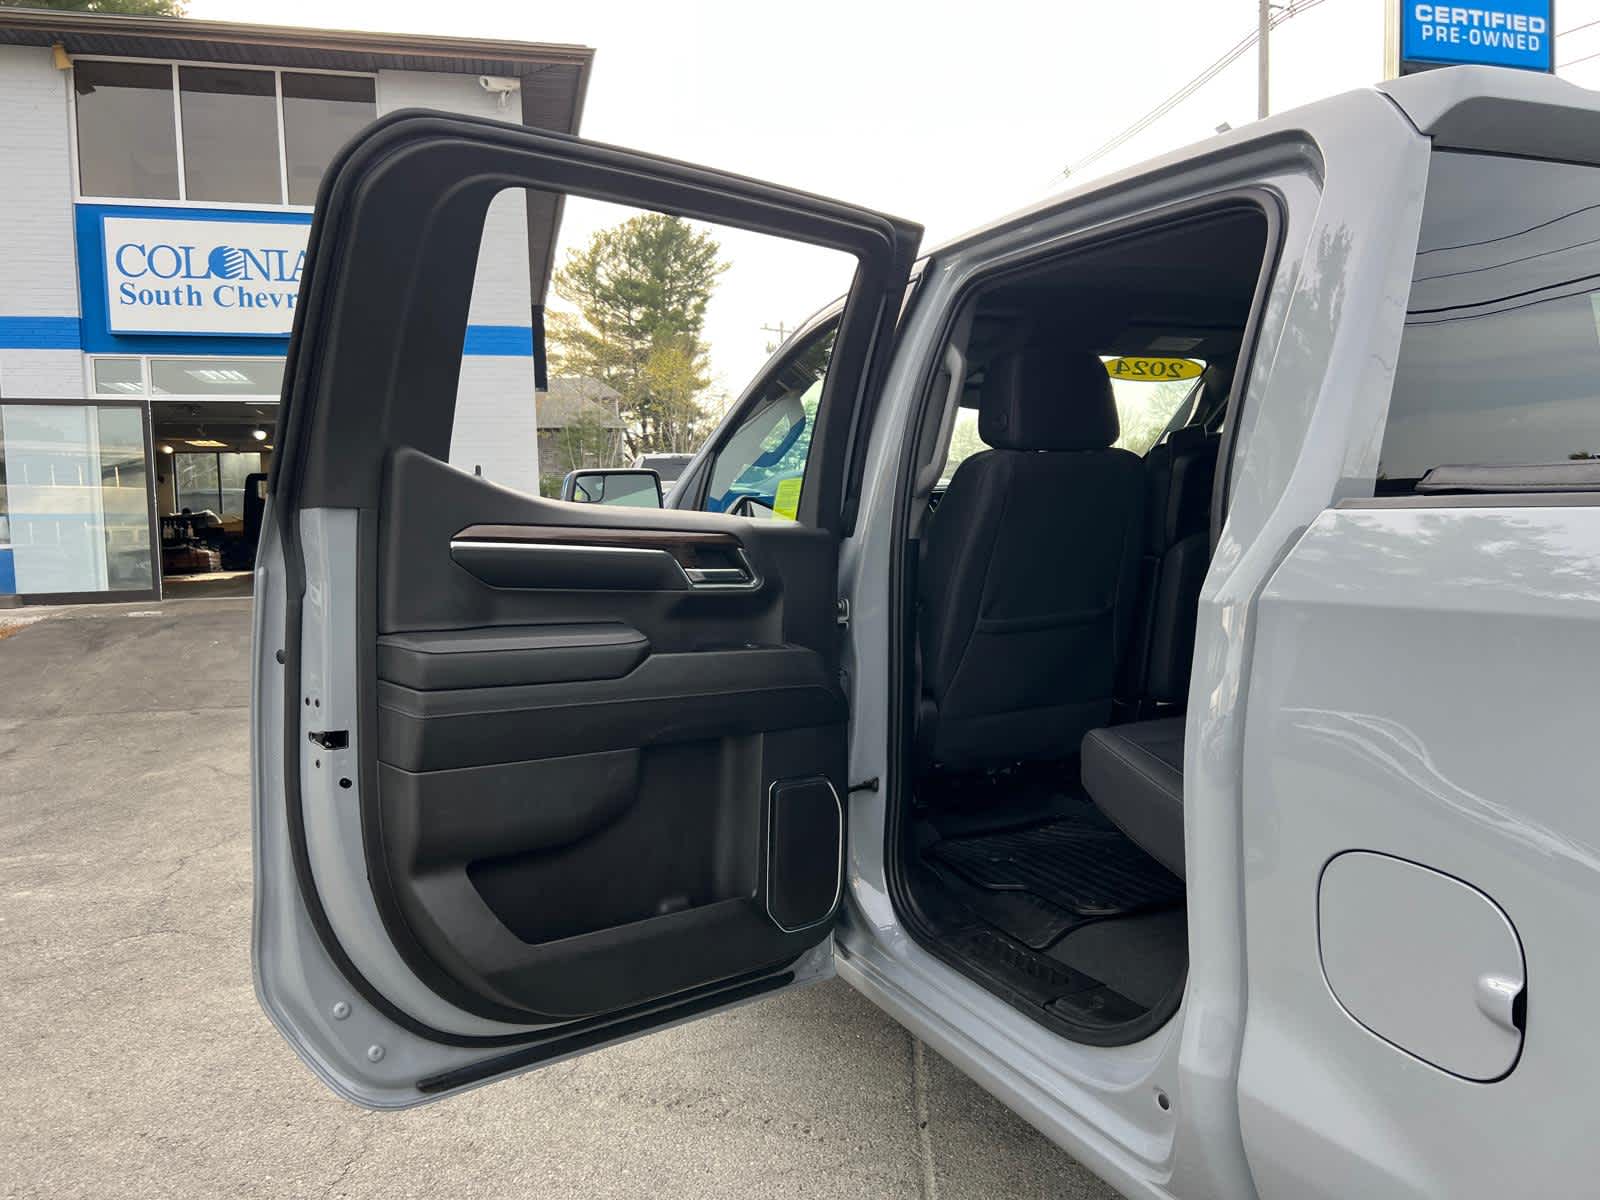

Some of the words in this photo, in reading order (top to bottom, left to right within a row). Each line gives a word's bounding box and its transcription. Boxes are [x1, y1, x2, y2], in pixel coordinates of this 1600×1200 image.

[1415, 4, 1546, 34] CERTIFIED
[1422, 25, 1540, 51] PRE-OWNED
[119, 283, 202, 308] South
